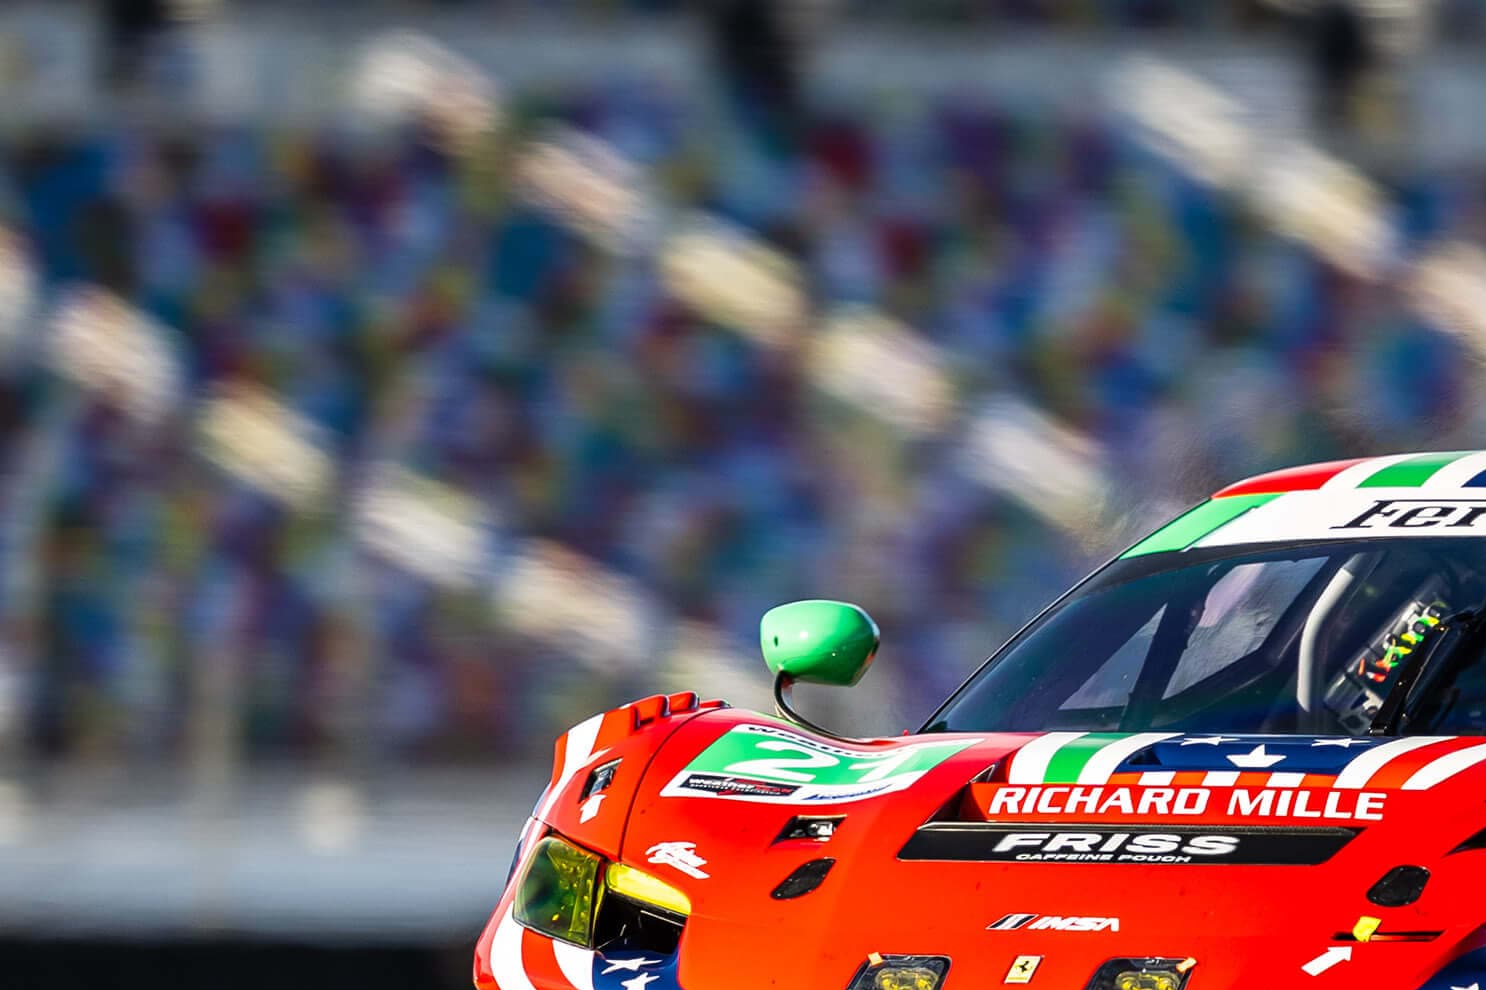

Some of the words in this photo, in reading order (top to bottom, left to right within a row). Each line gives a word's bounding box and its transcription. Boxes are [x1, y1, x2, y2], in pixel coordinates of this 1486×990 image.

[723, 741, 917, 783] 21
[988, 787, 1210, 815] RICHARD
[1227, 790, 1387, 820] MILLE
[992, 833, 1240, 855] FRISS
[1016, 852, 1113, 861] CAFFEINE
[1118, 854, 1192, 863] POUCH
[1027, 915, 1119, 932] IMSA
